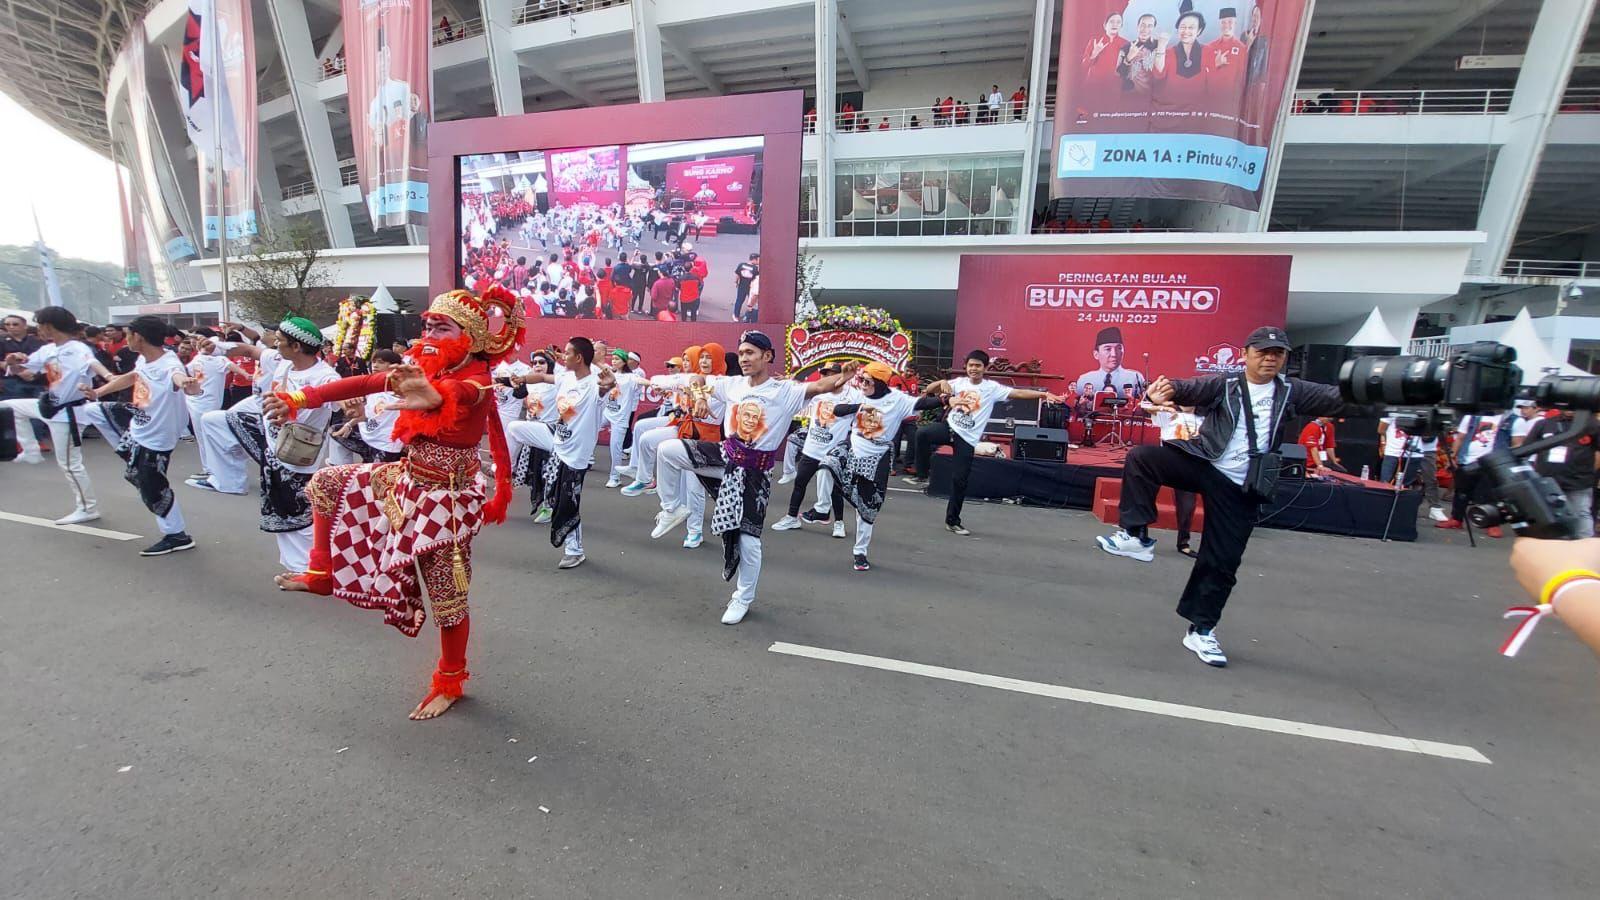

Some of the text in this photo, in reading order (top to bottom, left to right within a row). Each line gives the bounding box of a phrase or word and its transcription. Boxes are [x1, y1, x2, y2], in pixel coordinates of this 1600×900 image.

[1103, 149, 1147, 163] ZONA
[1153, 149, 1172, 163] 1A
[1186, 150, 1223, 168] Pintu
[1058, 273, 1187, 284] PERINGATAN BULAN
[1029, 288, 1214, 310] BUNG KARNO
[1077, 313, 1158, 324] 24 JUNI 2023
